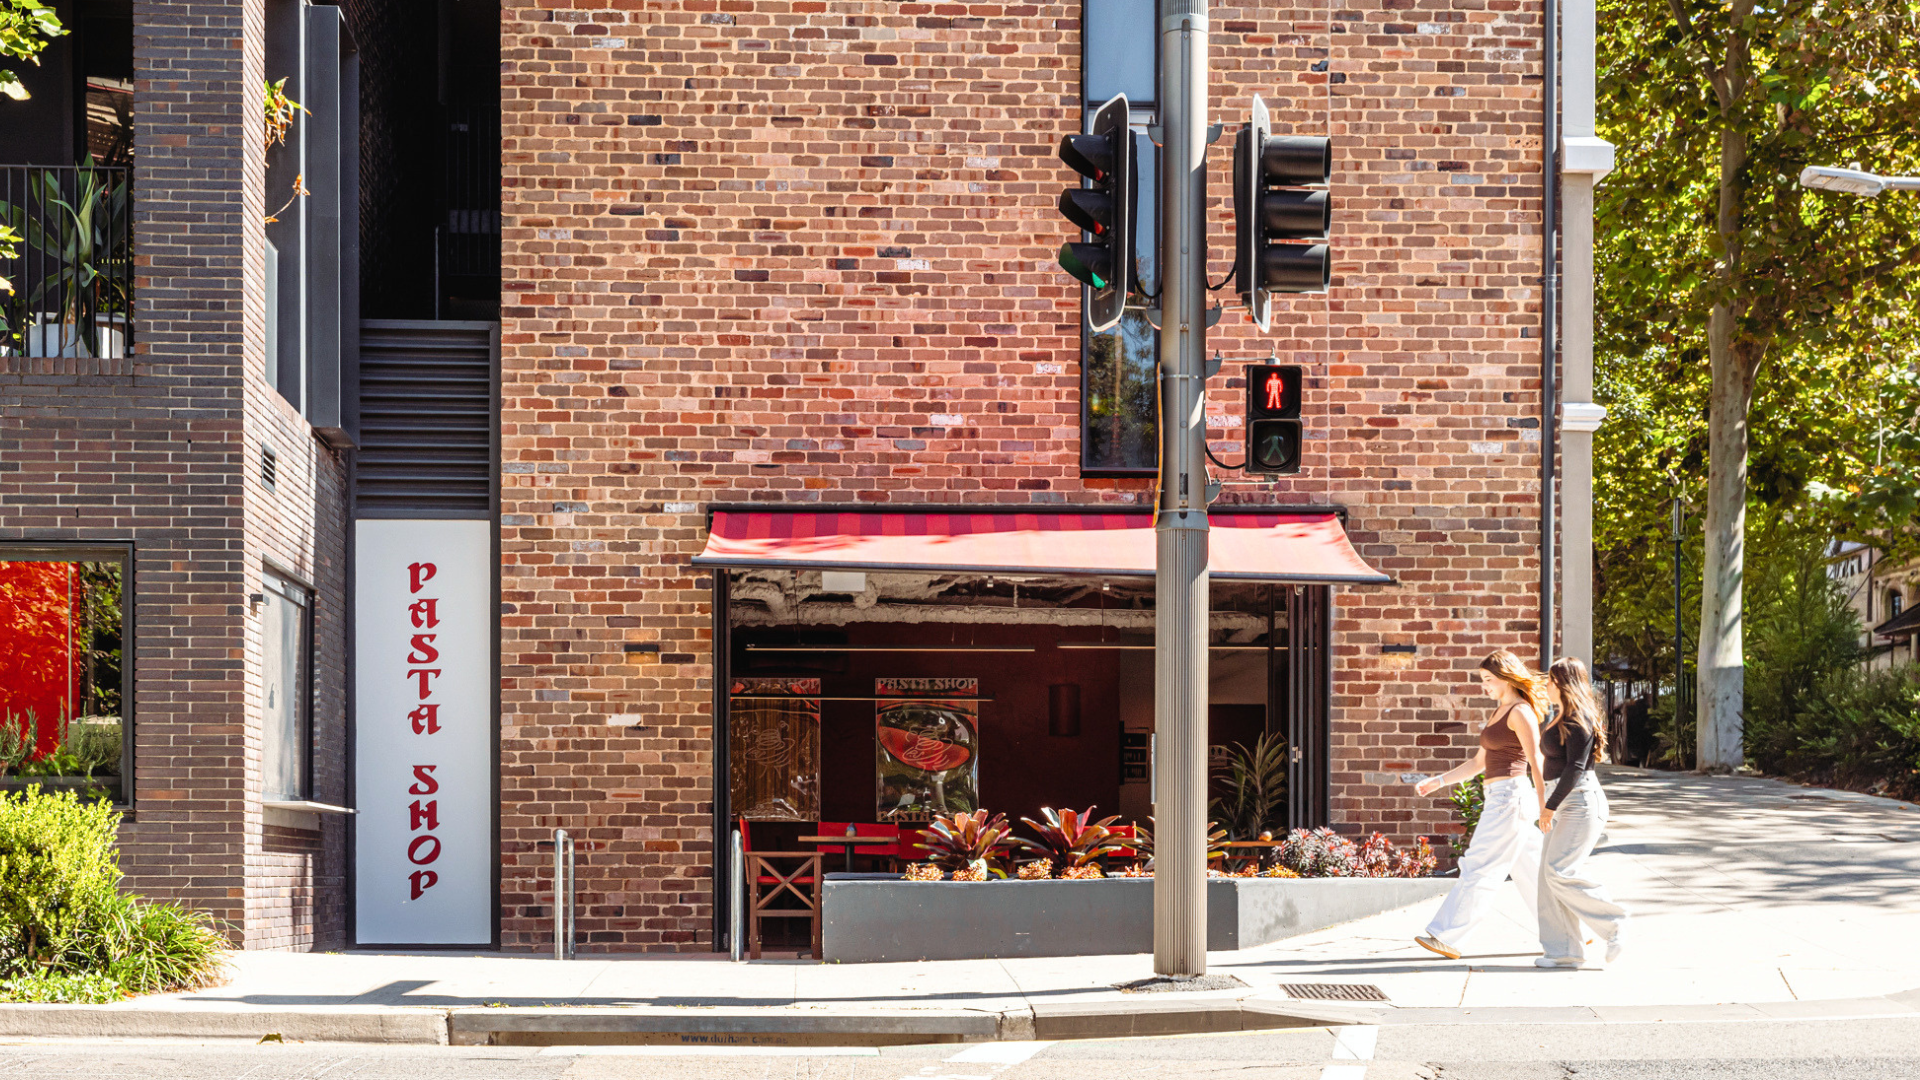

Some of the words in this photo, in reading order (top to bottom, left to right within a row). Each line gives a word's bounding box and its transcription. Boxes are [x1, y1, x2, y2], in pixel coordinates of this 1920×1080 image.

[407, 562, 441, 735] PASTA
[877, 678, 931, 691] PASTA
[934, 678, 978, 690] SHOP
[407, 765, 441, 900] SHOP
